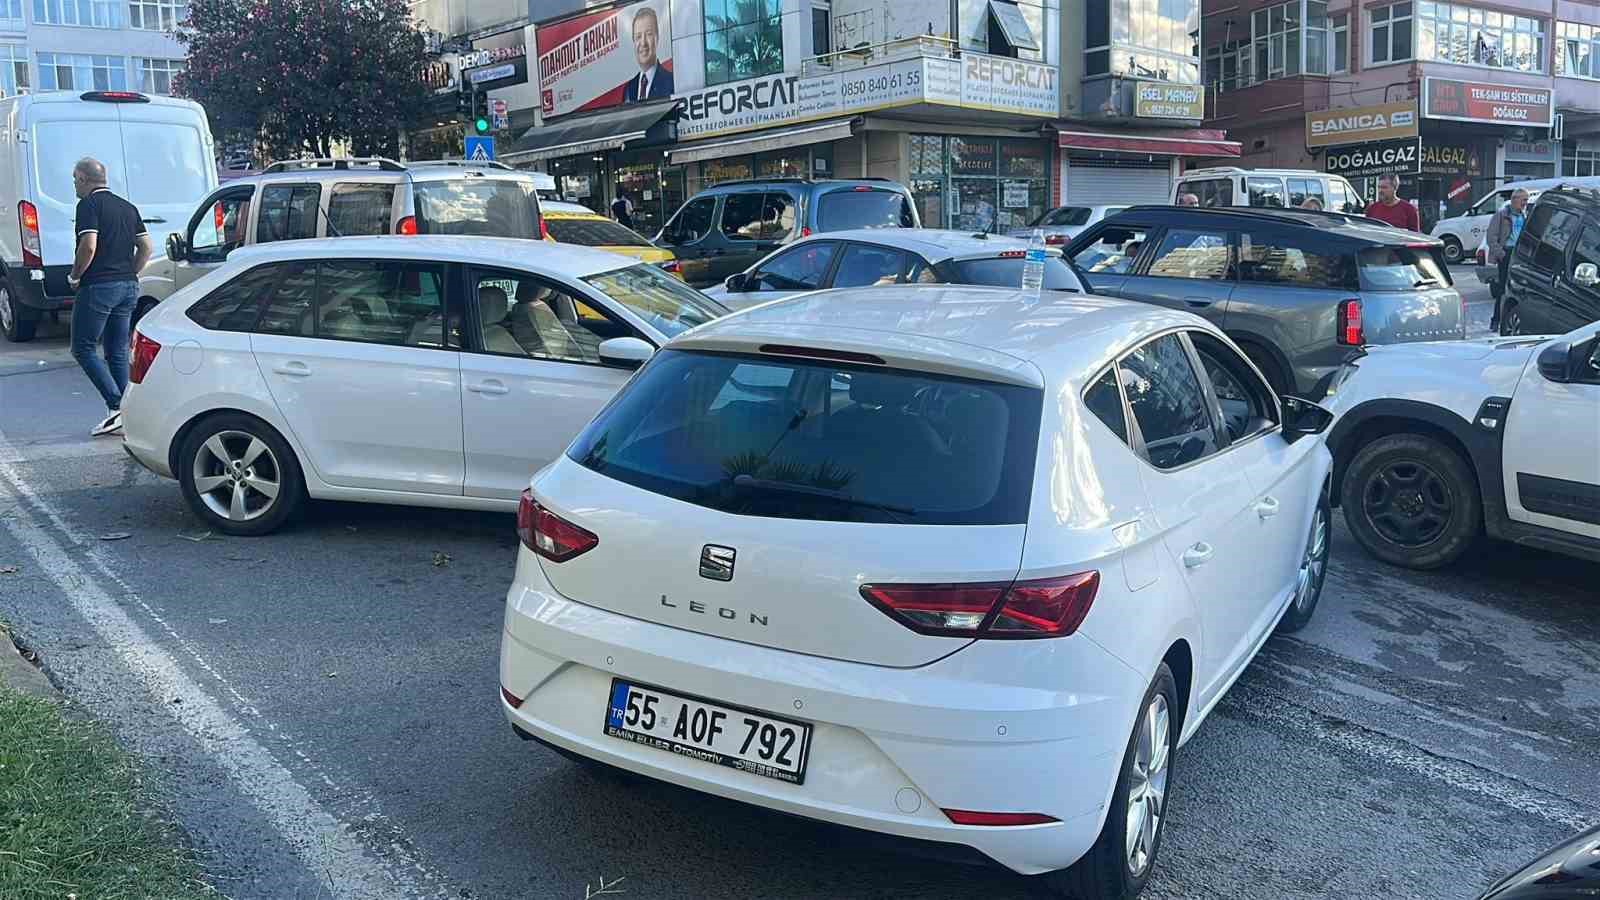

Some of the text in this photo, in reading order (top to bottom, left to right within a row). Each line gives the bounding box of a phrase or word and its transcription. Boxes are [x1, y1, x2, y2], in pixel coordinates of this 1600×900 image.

[540, 16, 618, 80] MAHMUT ARIKAN
[841, 80, 865, 97] 0850
[868, 77, 887, 92] 840
[890, 73, 902, 88] 61
[906, 71, 920, 86] 55
[967, 56, 1057, 90] REFORCAT
[676, 76, 799, 120] REFORCAT
[1311, 114, 1387, 134] SANICA
[1493, 106, 1528, 120] DOĞALGAZ
[679, 124, 704, 136] ILATES
[705, 117, 743, 131] REFORMER
[1327, 146, 1416, 171] DOĞALGAZ
[660, 594, 768, 627] LEON
[611, 707, 624, 721] TR
[625, 691, 796, 767] 55 AOF 792
[636, 734, 671, 751] ELLER
